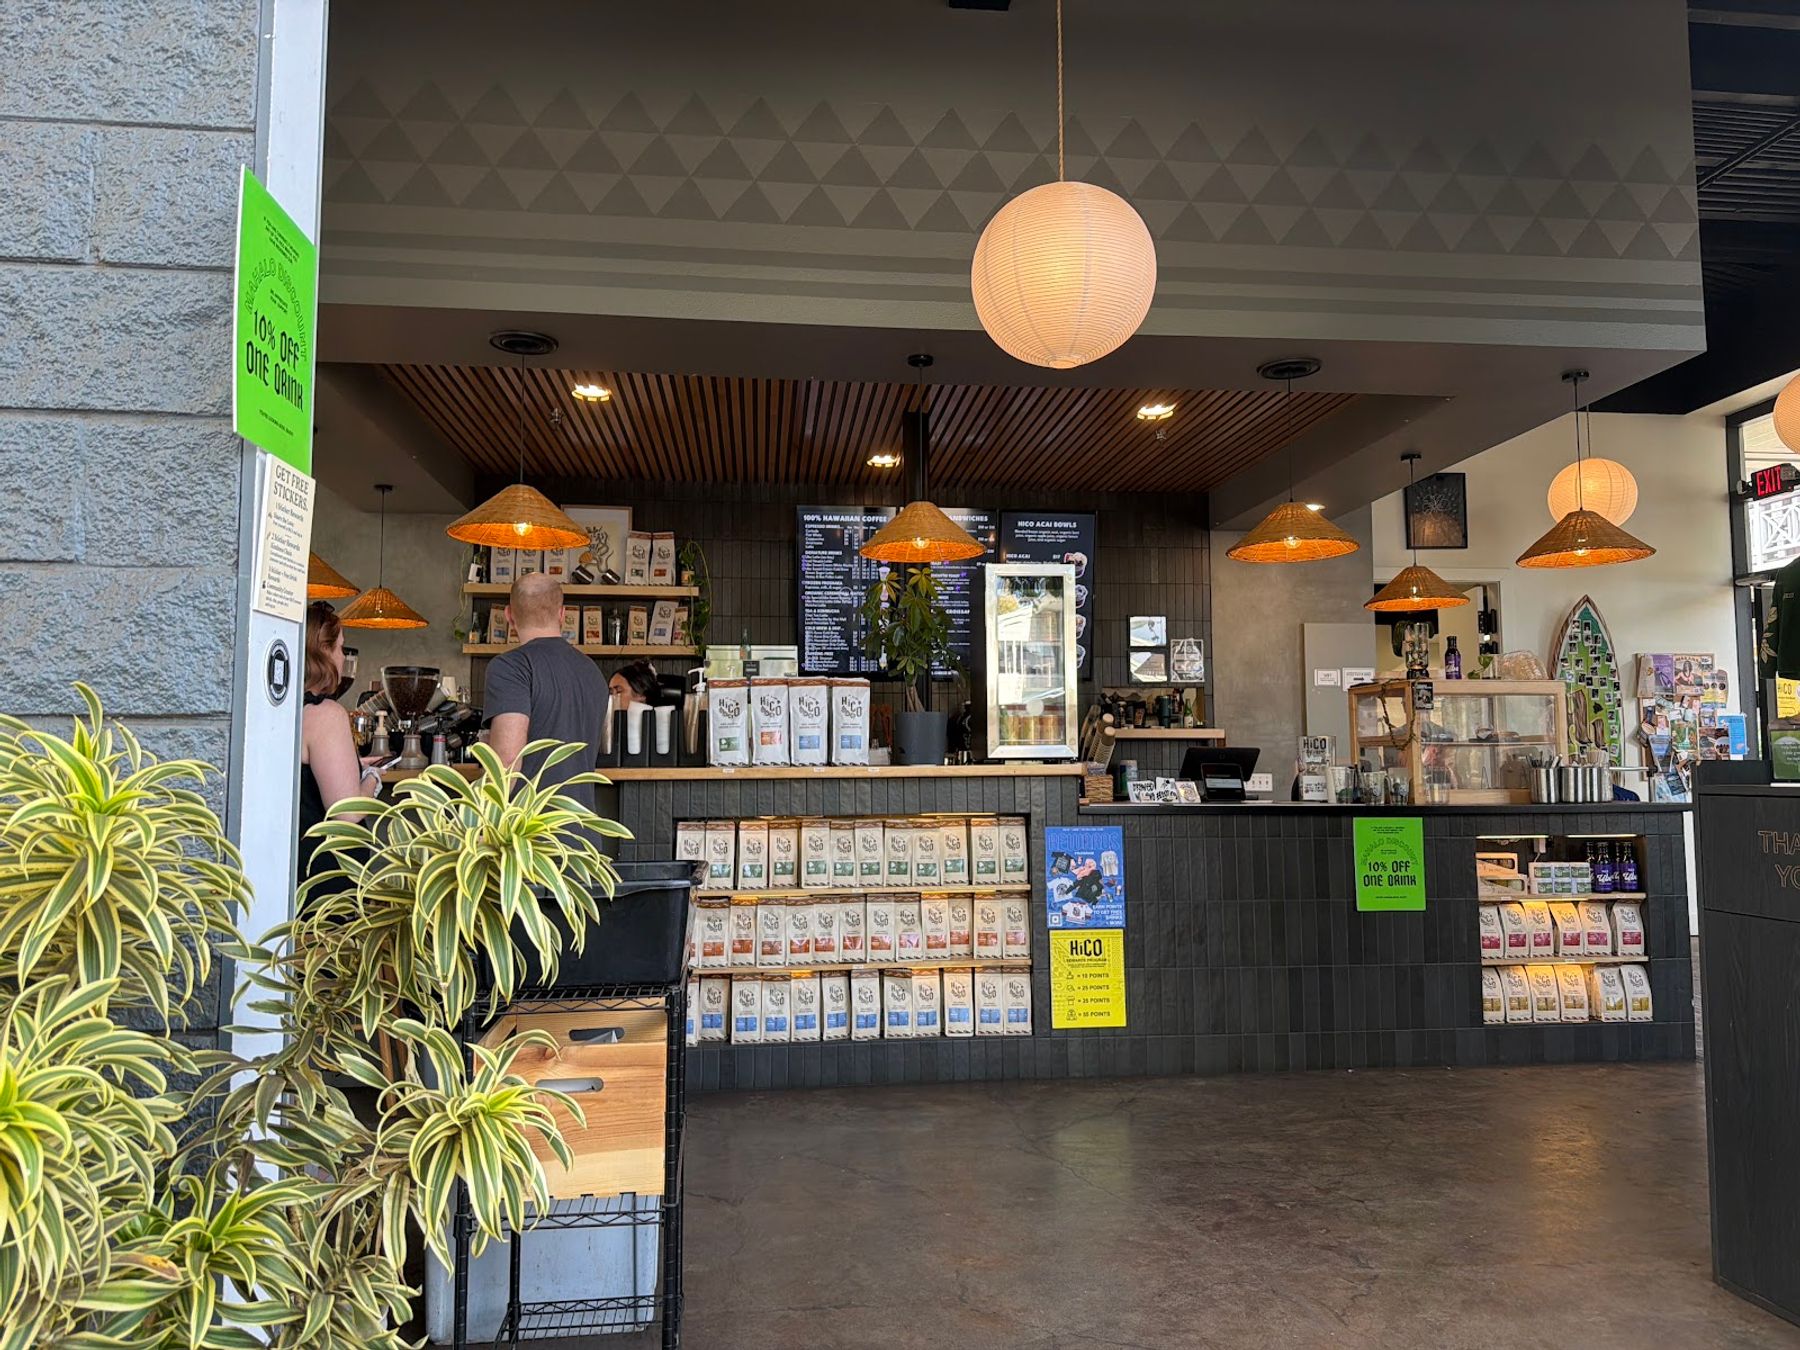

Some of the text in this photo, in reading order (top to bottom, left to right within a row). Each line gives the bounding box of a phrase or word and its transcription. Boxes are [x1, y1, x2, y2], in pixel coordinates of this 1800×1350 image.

[254, 309, 299, 372] 10% OFF
[246, 340, 303, 412] ONE DRINK
[276, 465, 309, 495] GET FREE
[1756, 465, 1781, 496] EXIT
[274, 481, 308, 511] STICKERS.
[719, 698, 740, 717] HiCO
[760, 696, 782, 716] HiCO
[799, 696, 820, 717] HiCO
[841, 696, 863, 717] HiCO
[1303, 738, 1327, 750] HiCO
[1368, 860, 1410, 873] 10% OFF
[1363, 875, 1417, 887] ONE DRINK
[1070, 938, 1103, 957] HiCO
